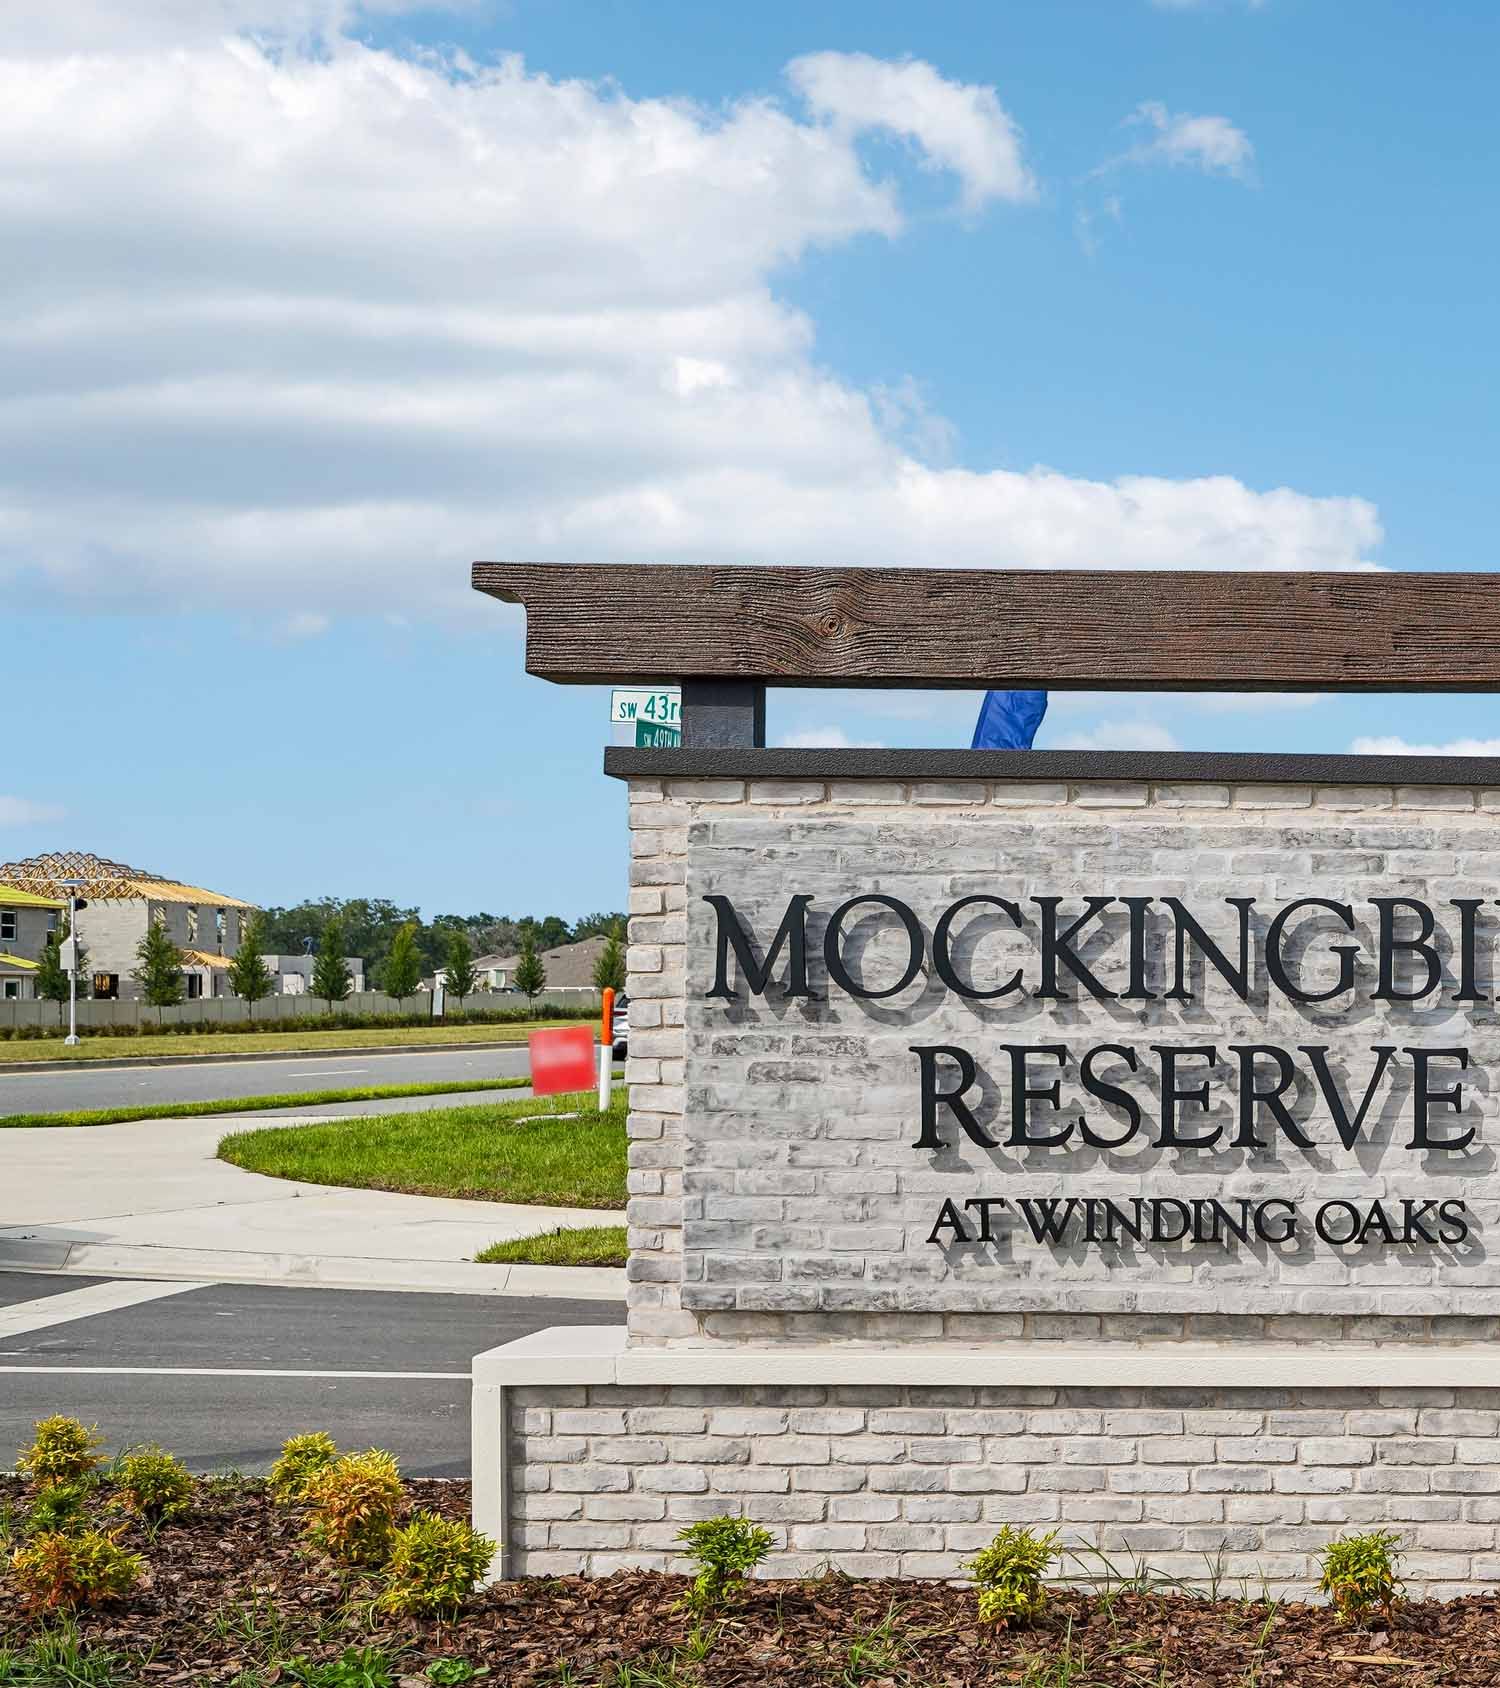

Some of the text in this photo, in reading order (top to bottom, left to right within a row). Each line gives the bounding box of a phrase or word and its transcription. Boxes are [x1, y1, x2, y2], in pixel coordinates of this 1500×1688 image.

[619, 702, 638, 719] SW
[909, 1044, 1476, 1151] RESERVE
[926, 1198, 1468, 1245] AT WINDING OAKS
